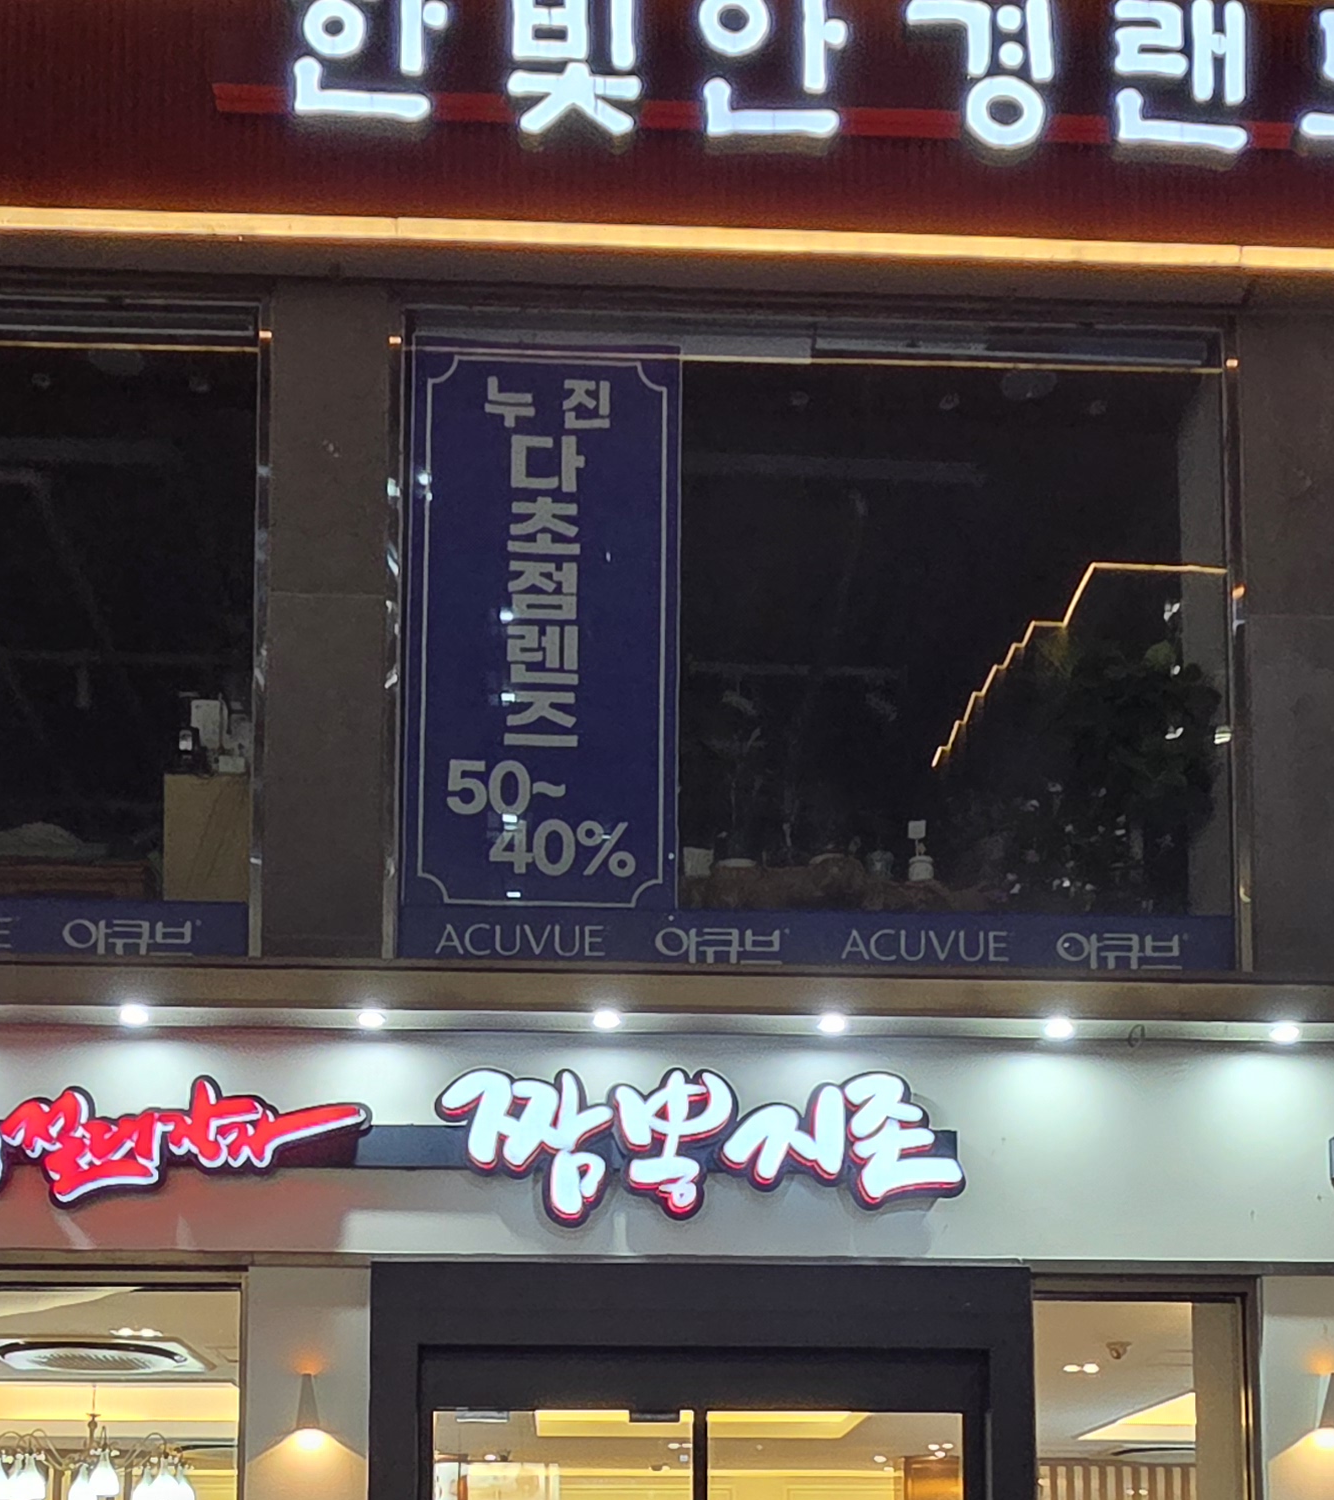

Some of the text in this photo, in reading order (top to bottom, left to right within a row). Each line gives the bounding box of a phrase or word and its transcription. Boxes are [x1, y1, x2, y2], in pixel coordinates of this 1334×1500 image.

[503, 434, 585, 748] 다초점렌즈
[488, 819, 637, 878] 40%
[62, 917, 196, 956] 아큐브
[434, 924, 1184, 970] ACUVUE 아큐브 ACUVUE 아큐브
